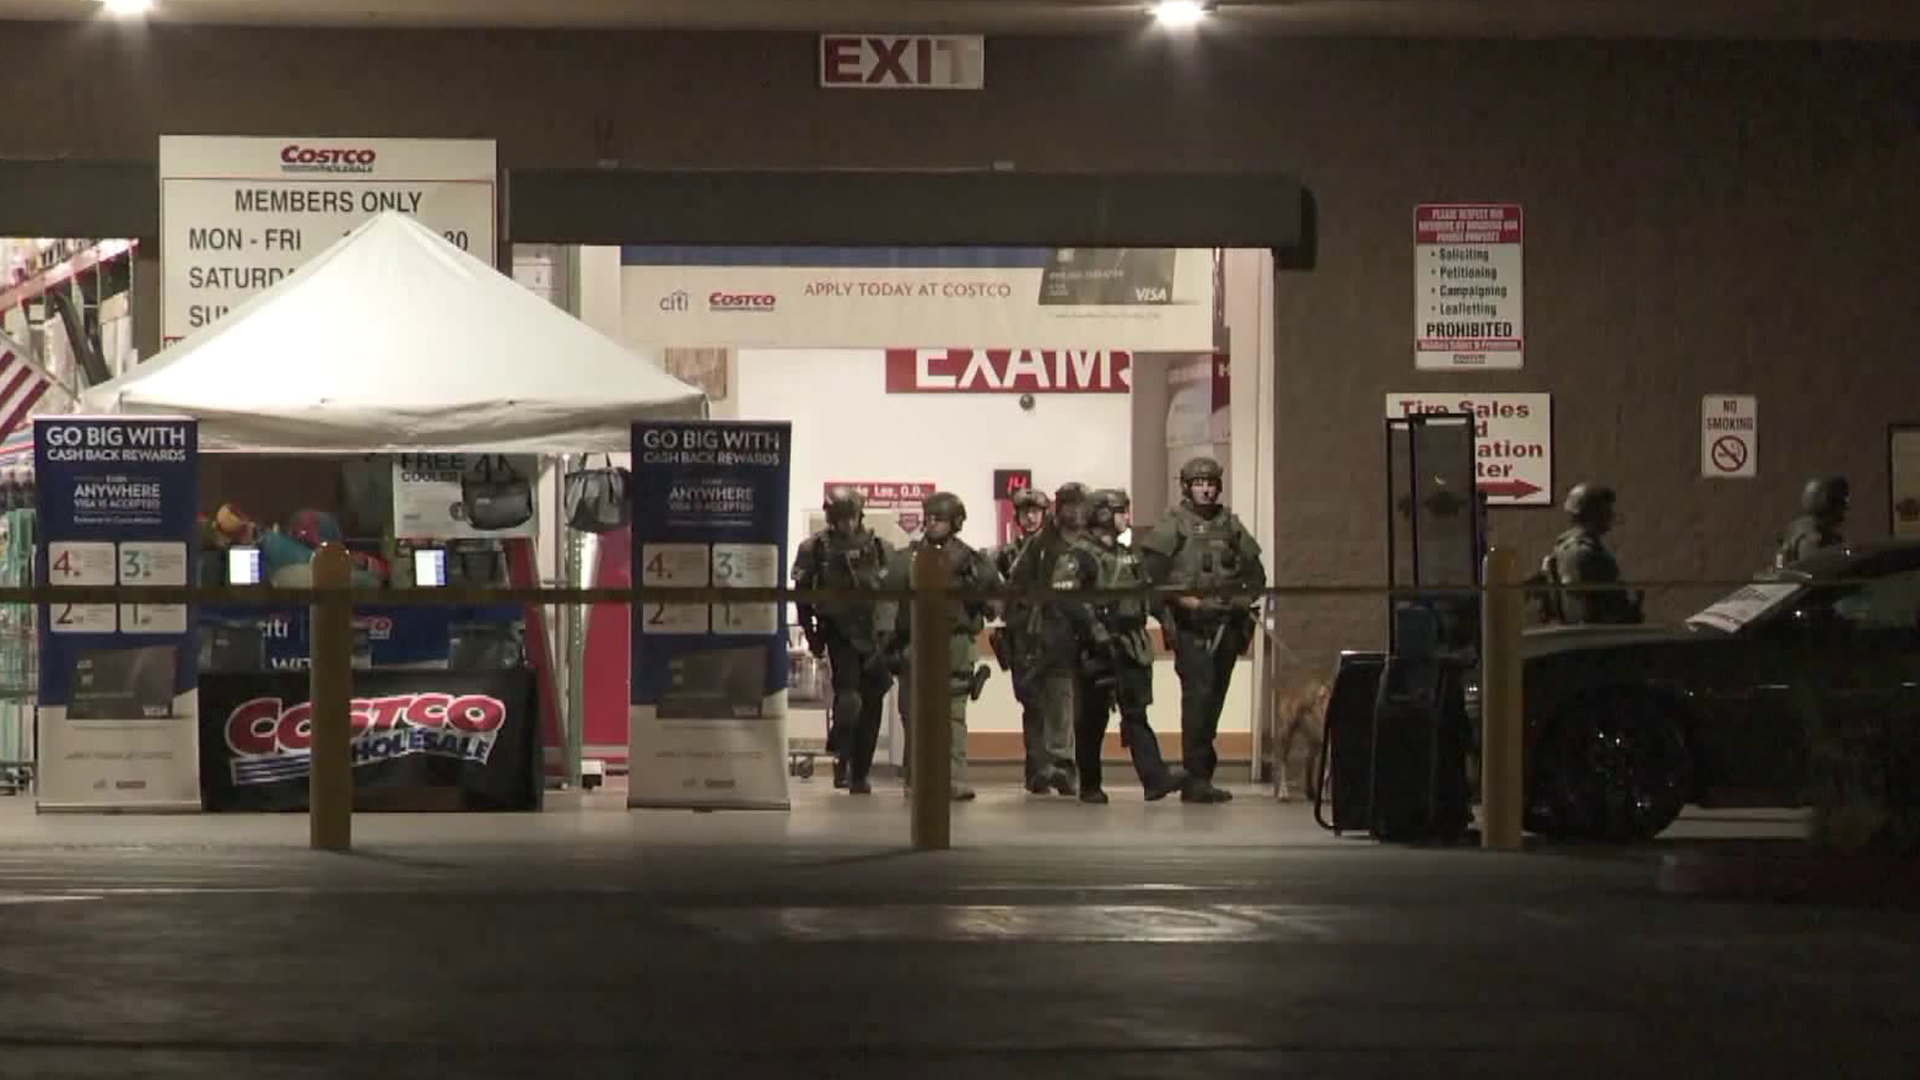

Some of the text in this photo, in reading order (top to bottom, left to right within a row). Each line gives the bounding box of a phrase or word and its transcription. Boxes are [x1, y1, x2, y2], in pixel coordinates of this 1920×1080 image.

[824, 39, 966, 84] EXIT
[281, 145, 376, 163] COSTCO
[235, 190, 422, 213] MEMBERS ONLY
[189, 228, 242, 250] MON
[265, 229, 301, 250] FRI
[1439, 248, 1488, 262] Soliciting
[1439, 266, 1497, 280] Petitioning
[804, 282, 1011, 297] APPLY TODAY AT COSTCO
[1135, 287, 1167, 301] VISA
[1439, 285, 1507, 298] Campaigning
[659, 290, 688, 311] citi
[709, 292, 776, 306] COSTCO
[1440, 303, 1497, 317] Leafletting
[1426, 322, 1512, 337] PROHIBITED
[1399, 401, 1529, 418] Tire Sales
[1723, 400, 1737, 414] NO
[1706, 417, 1753, 431] SMOKING
[46, 427, 185, 446] GO BIG WITH
[643, 430, 780, 449] GO BIG WITH
[47, 450, 185, 461] CASH BACK REWARDS
[1478, 439, 1543, 458] ation
[401, 453, 466, 469] FREE
[643, 453, 780, 465] CASH BACK REWARDS
[1478, 461, 1513, 477] ter
[402, 472, 458, 482] COOLER
[74, 484, 160, 497] ANYWHERE
[670, 487, 753, 500] ANYWHERE
[224, 693, 506, 756] COSTCO
[350, 727, 497, 765] HOLESALE
